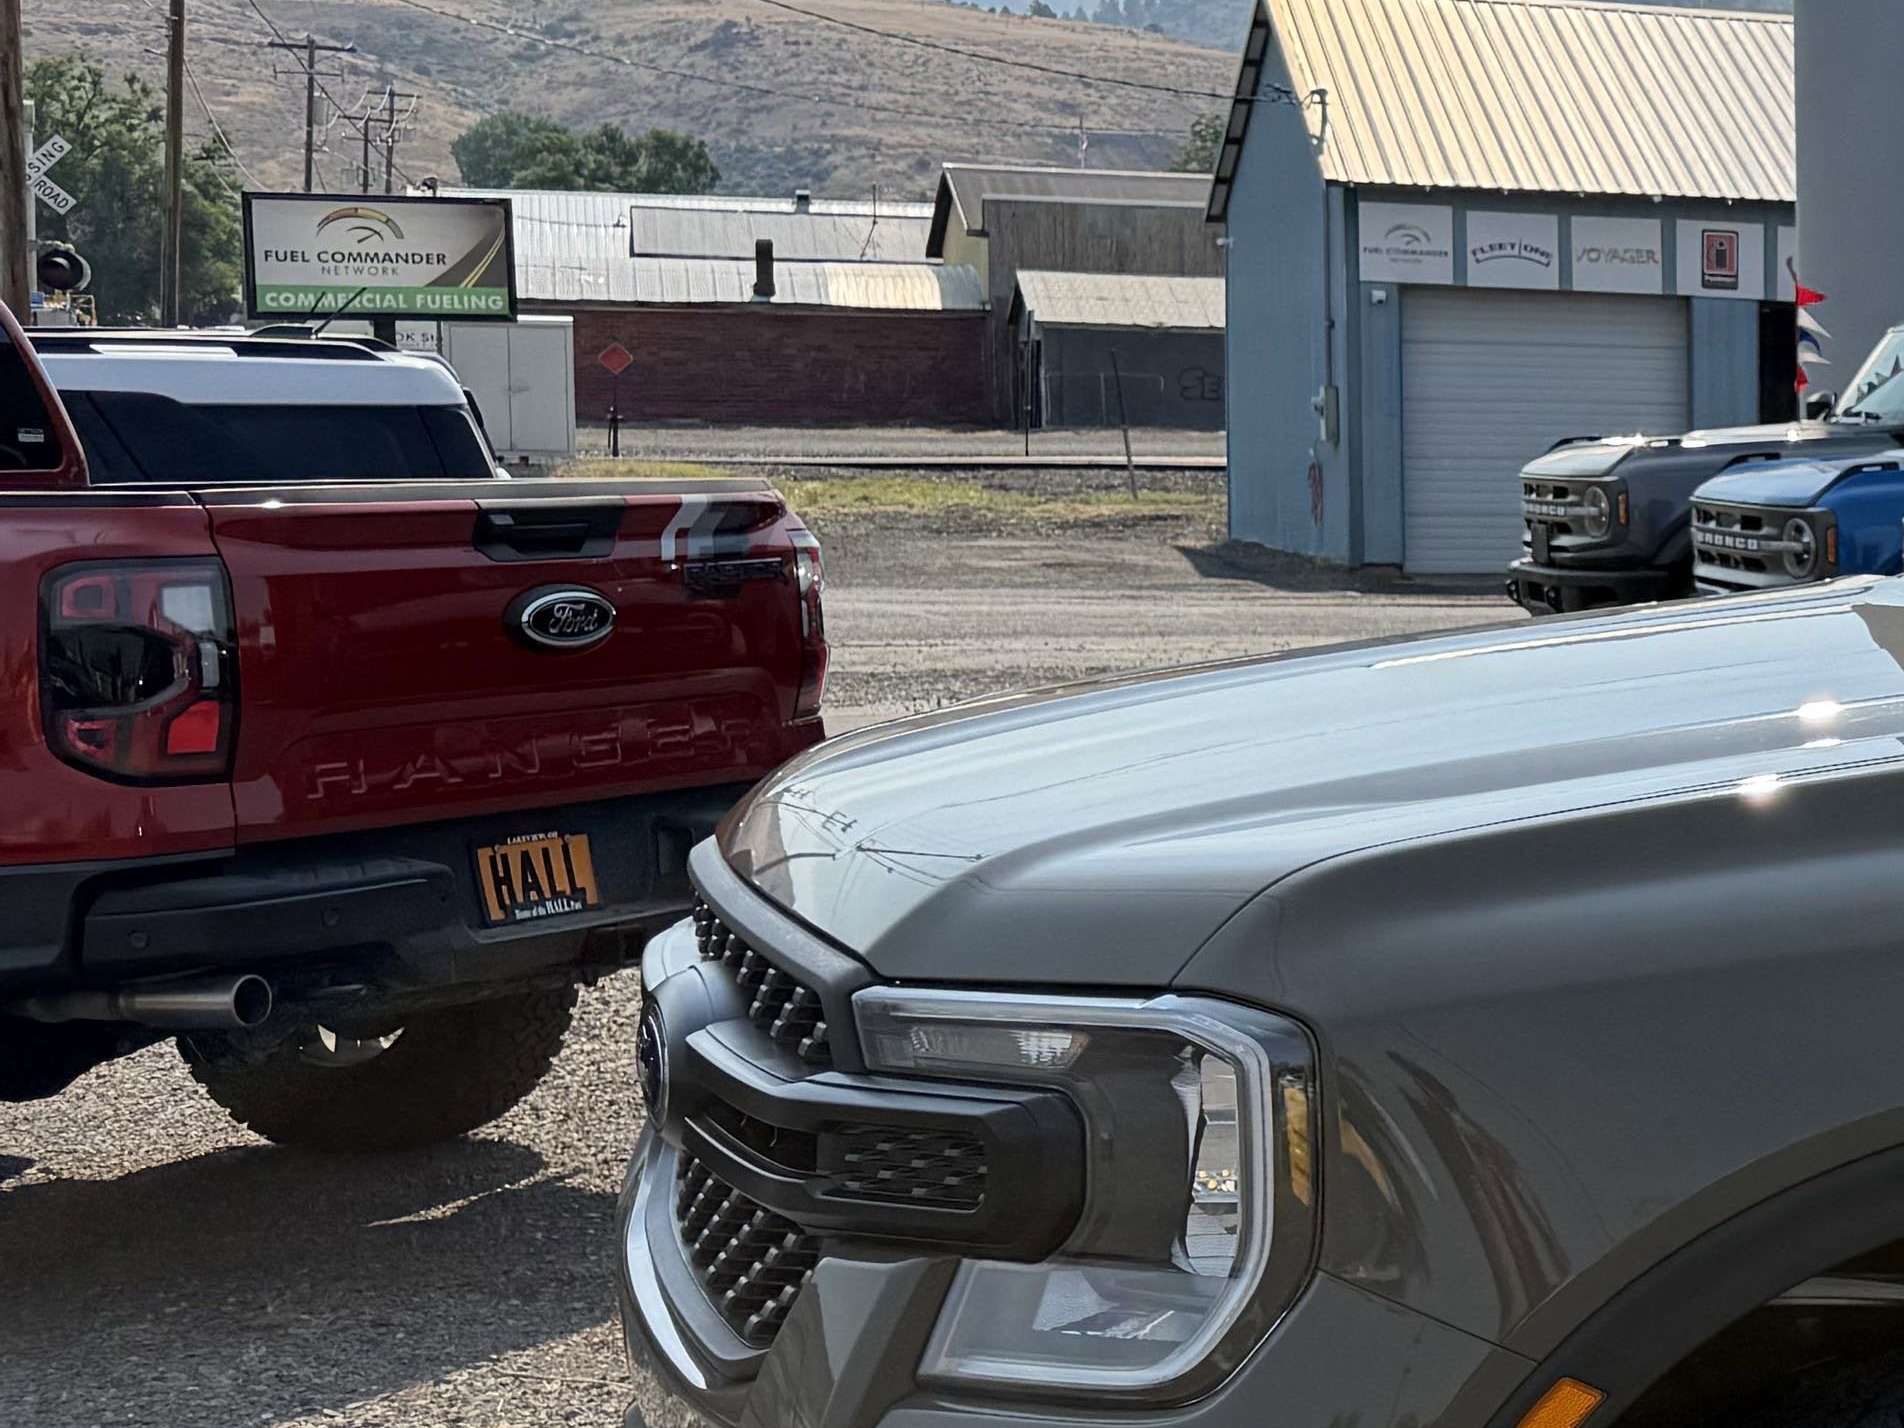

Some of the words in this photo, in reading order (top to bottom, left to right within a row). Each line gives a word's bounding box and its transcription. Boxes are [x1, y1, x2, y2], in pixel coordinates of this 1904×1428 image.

[34, 180, 69, 208] ROAD
[264, 250, 310, 262] FUEL
[317, 251, 446, 265] COMMANDER
[1576, 247, 1659, 264] VOYAGER
[321, 266, 399, 277] NETWORK
[265, 294, 407, 309] COMMERCIAL
[416, 294, 503, 309] FUELING
[1697, 530, 1759, 550] BRONCO
[549, 603, 599, 633] Ford
[488, 843, 586, 911] HALL
